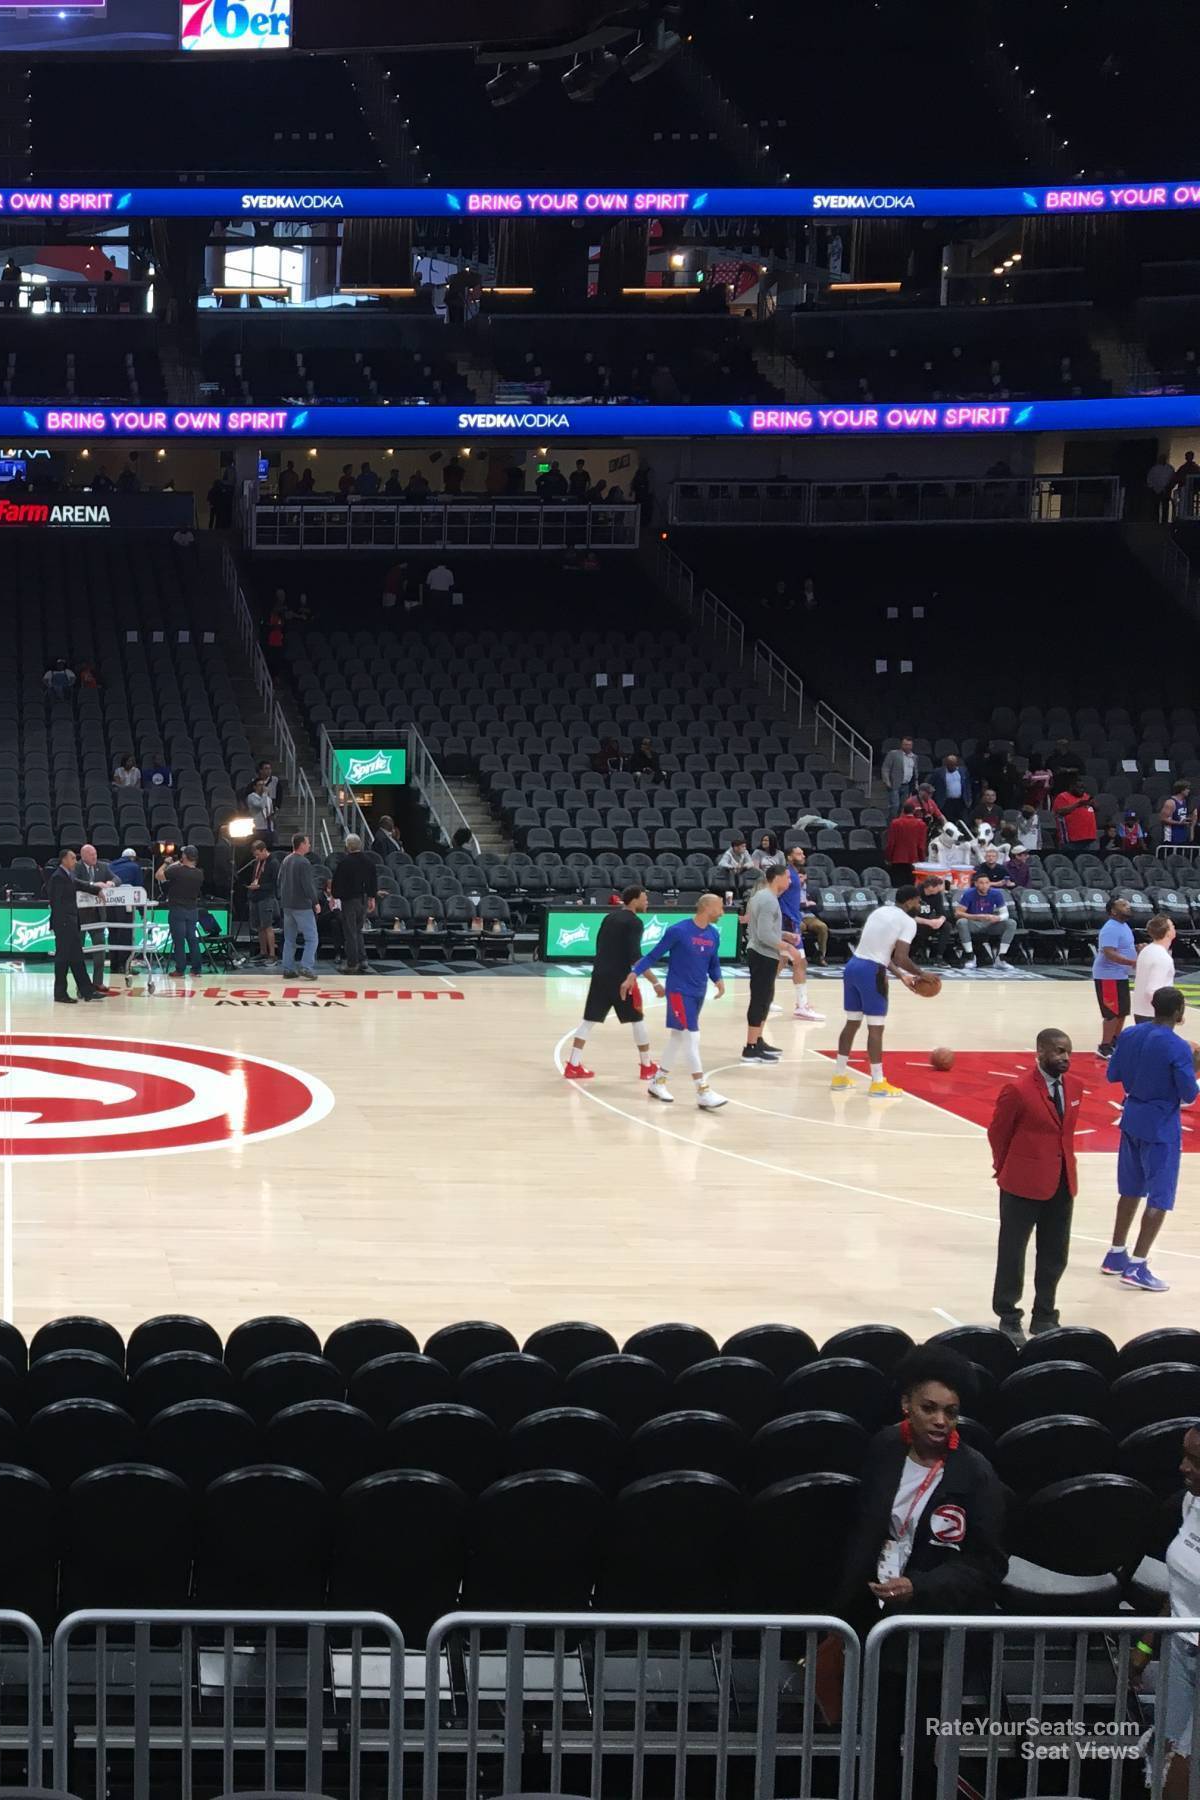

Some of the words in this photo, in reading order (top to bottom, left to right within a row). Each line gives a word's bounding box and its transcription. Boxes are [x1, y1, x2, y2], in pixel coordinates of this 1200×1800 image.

[10, 193, 52, 210] OWN
[59, 193, 112, 210] SPIRIT
[468, 194, 522, 211] BRING
[528, 194, 578, 210] YOUR
[585, 194, 628, 210] OWN
[634, 194, 688, 210] SPIRIT
[1046, 190, 1105, 208] BRING
[1110, 187, 1166, 205] YOUR
[47, 412, 106, 430] BRING
[111, 412, 166, 430] YOUR
[174, 412, 221, 430] OWN
[228, 412, 287, 429] SPIRIT
[751, 411, 812, 430] BRING
[818, 409, 878, 428] YOUR
[886, 408, 938, 427] OWN
[944, 407, 1010, 426] SPIRIT
[50, 505, 111, 522] ARENA
[349, 755, 388, 780] Sprite
[281, 987, 465, 1000] Farm
[214, 1000, 351, 1008] ARENA
